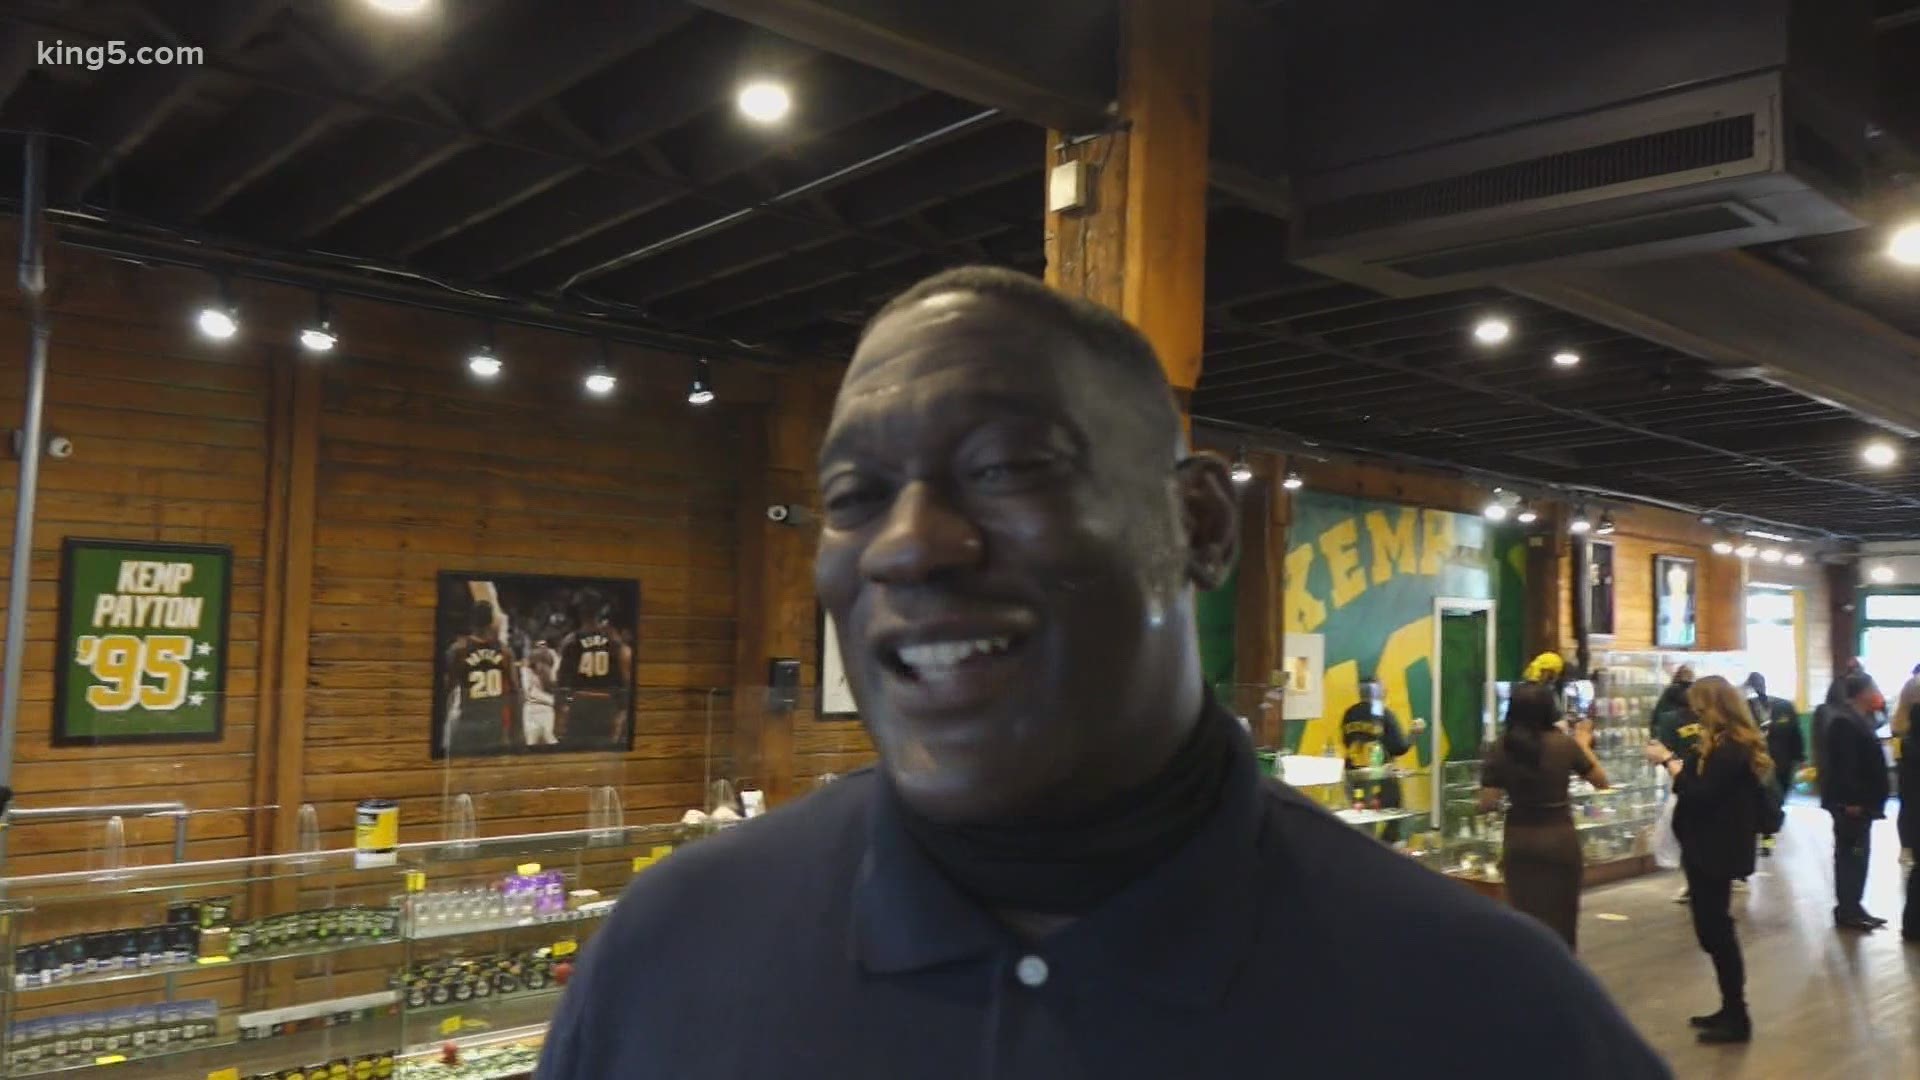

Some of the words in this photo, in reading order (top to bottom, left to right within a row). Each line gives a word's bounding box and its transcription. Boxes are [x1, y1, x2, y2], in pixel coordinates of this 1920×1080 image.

[117, 560, 193, 594] KEMP
[1284, 507, 1457, 633] KEMP
[92, 593, 204, 628] PAYTON
[579, 651, 610, 677] 40
[468, 669, 502, 699] 20
